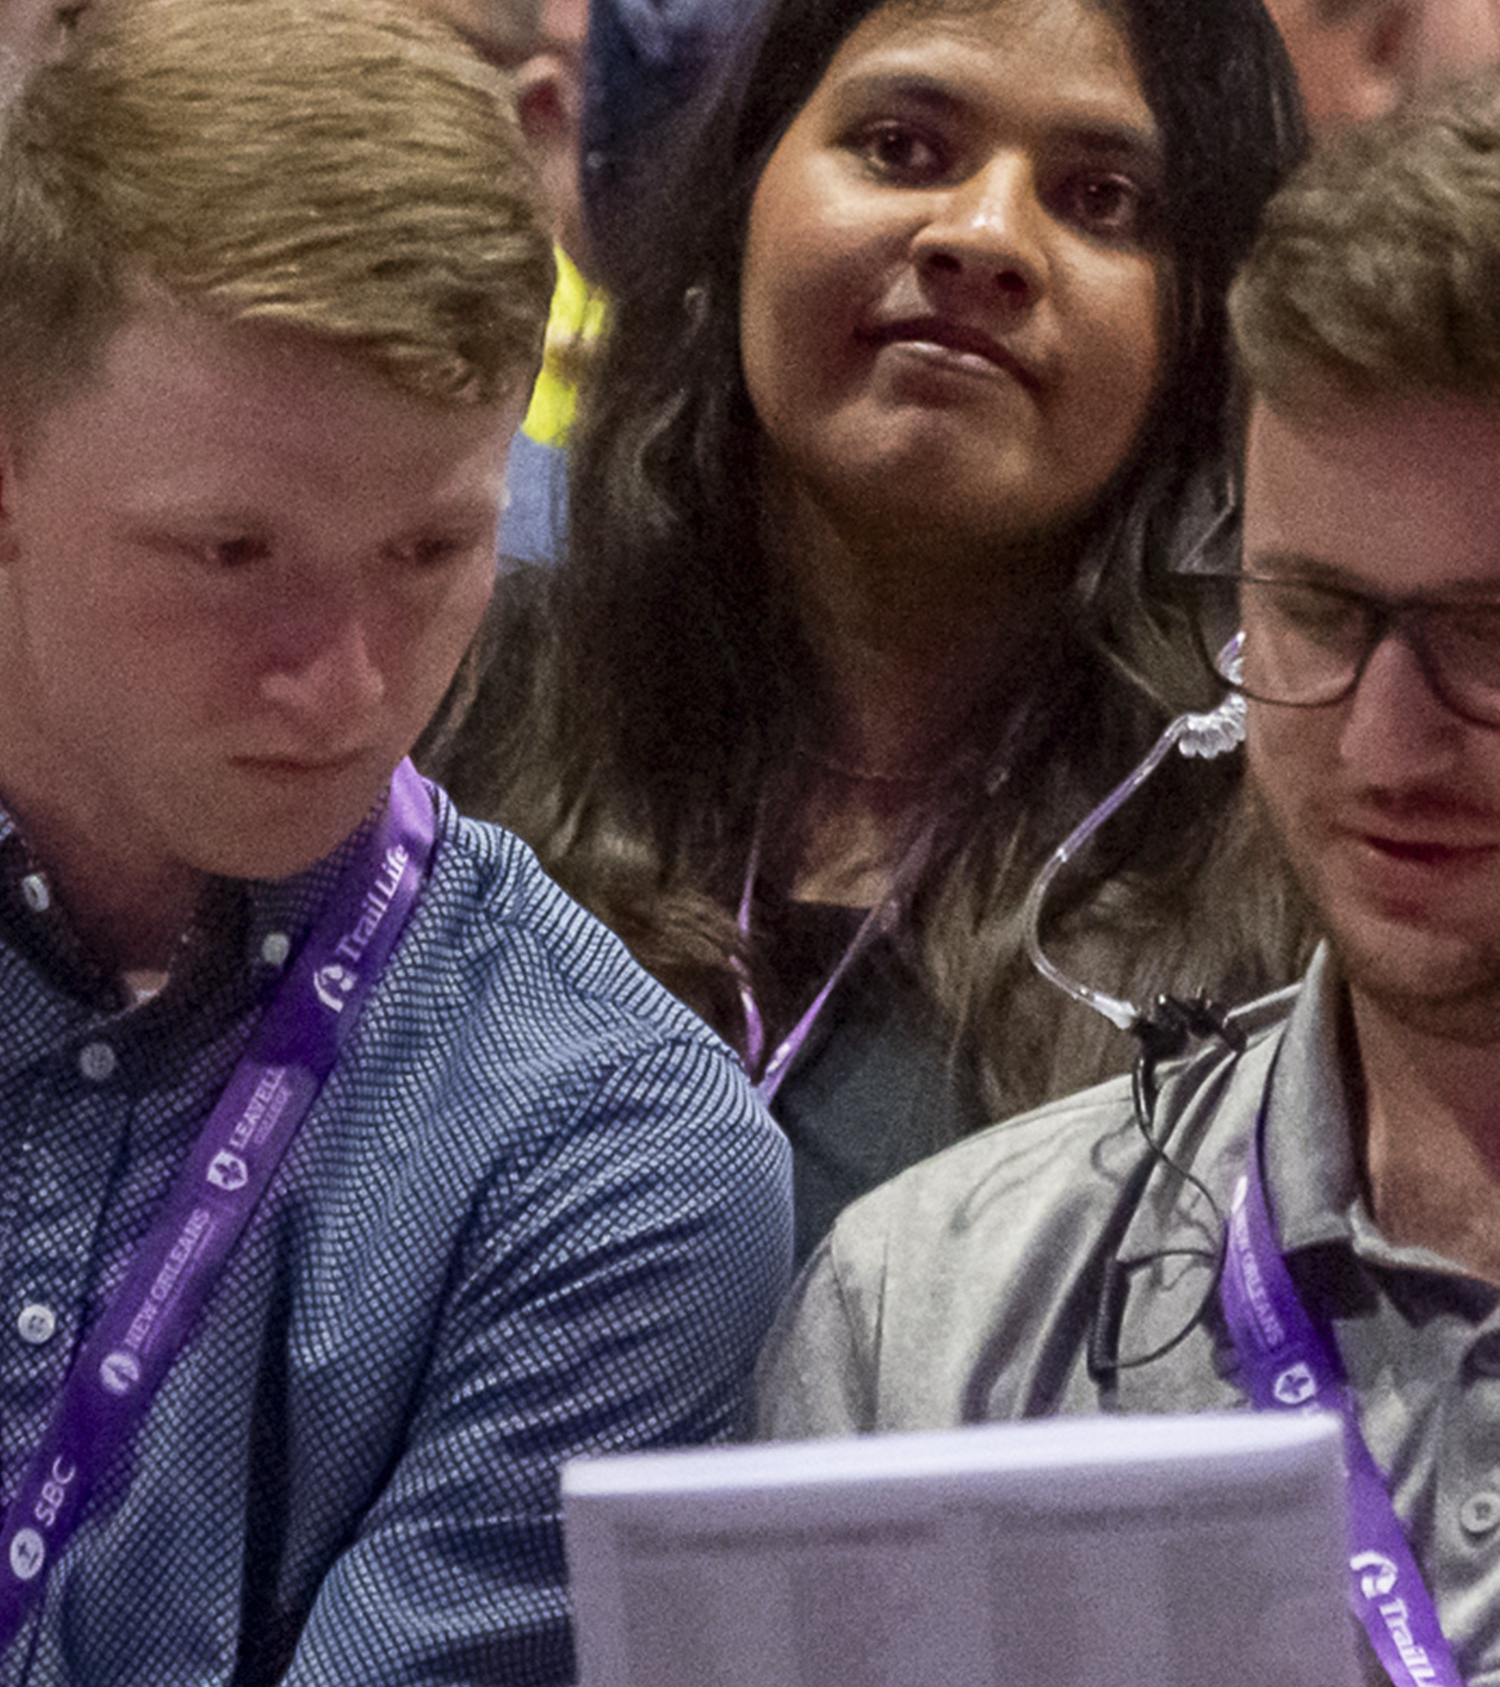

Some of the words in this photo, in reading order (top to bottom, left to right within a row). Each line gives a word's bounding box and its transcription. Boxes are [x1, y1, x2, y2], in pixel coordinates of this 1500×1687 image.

[229, 1067, 287, 1150] LEAVELL
[124, 1298, 158, 1350] NEW
[151, 1208, 210, 1300] ORLEANS
[34, 1455, 76, 1527] SBC
